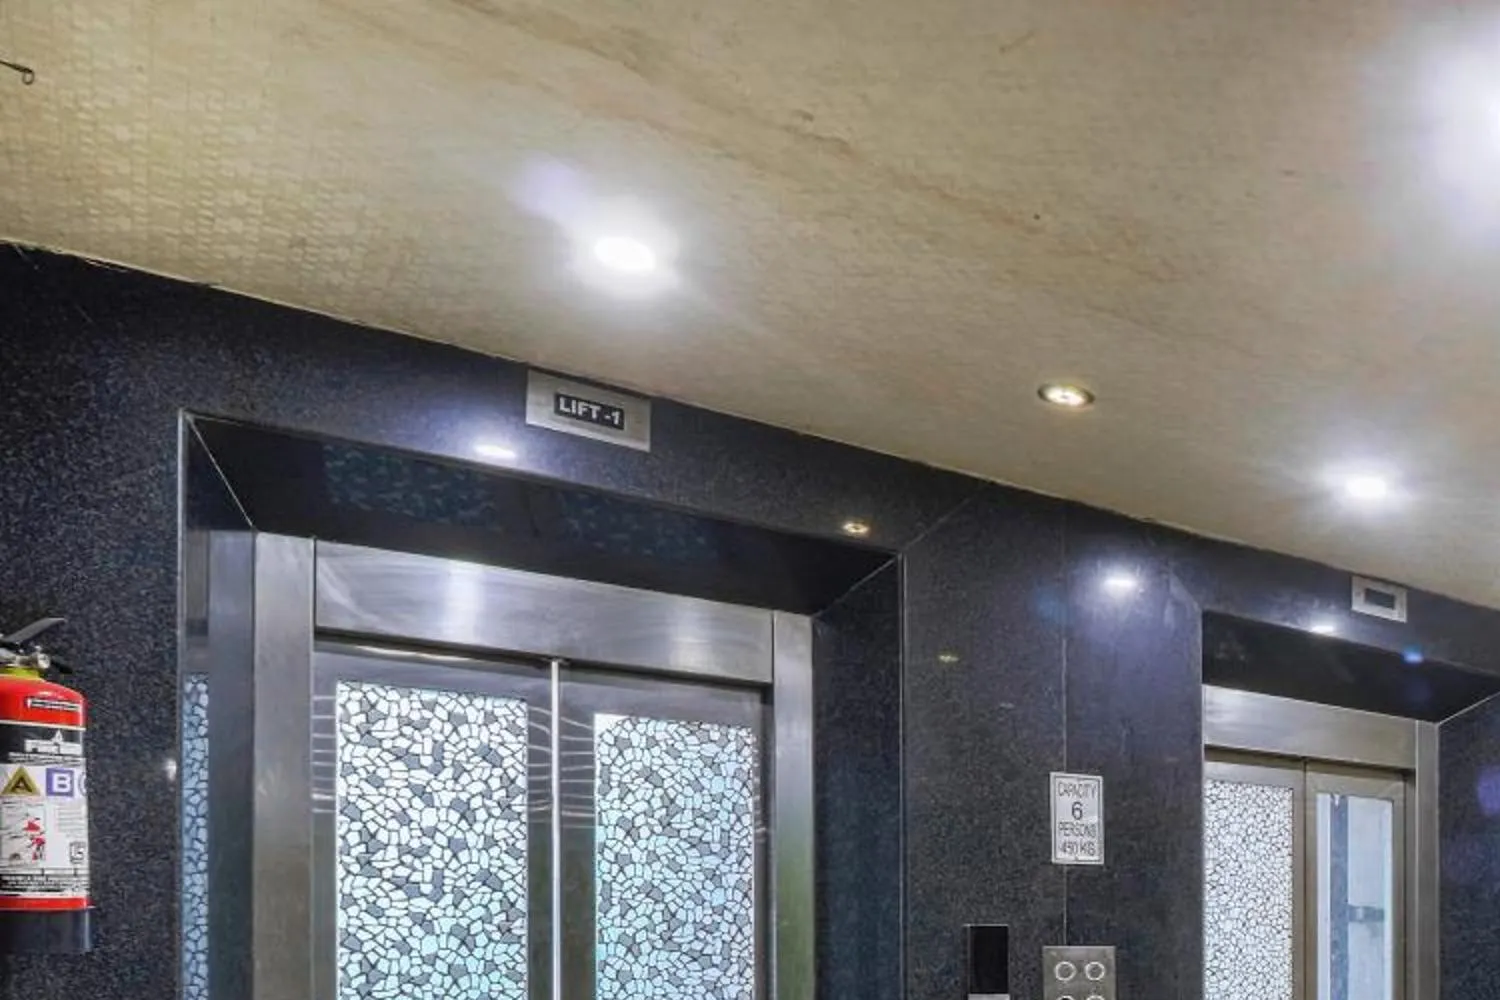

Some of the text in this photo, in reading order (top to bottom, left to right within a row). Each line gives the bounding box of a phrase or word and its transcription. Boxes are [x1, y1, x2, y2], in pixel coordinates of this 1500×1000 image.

[11, 777, 33, 793] A
[53, 772, 71, 793] B
[1071, 801, 1083, 820] 6
